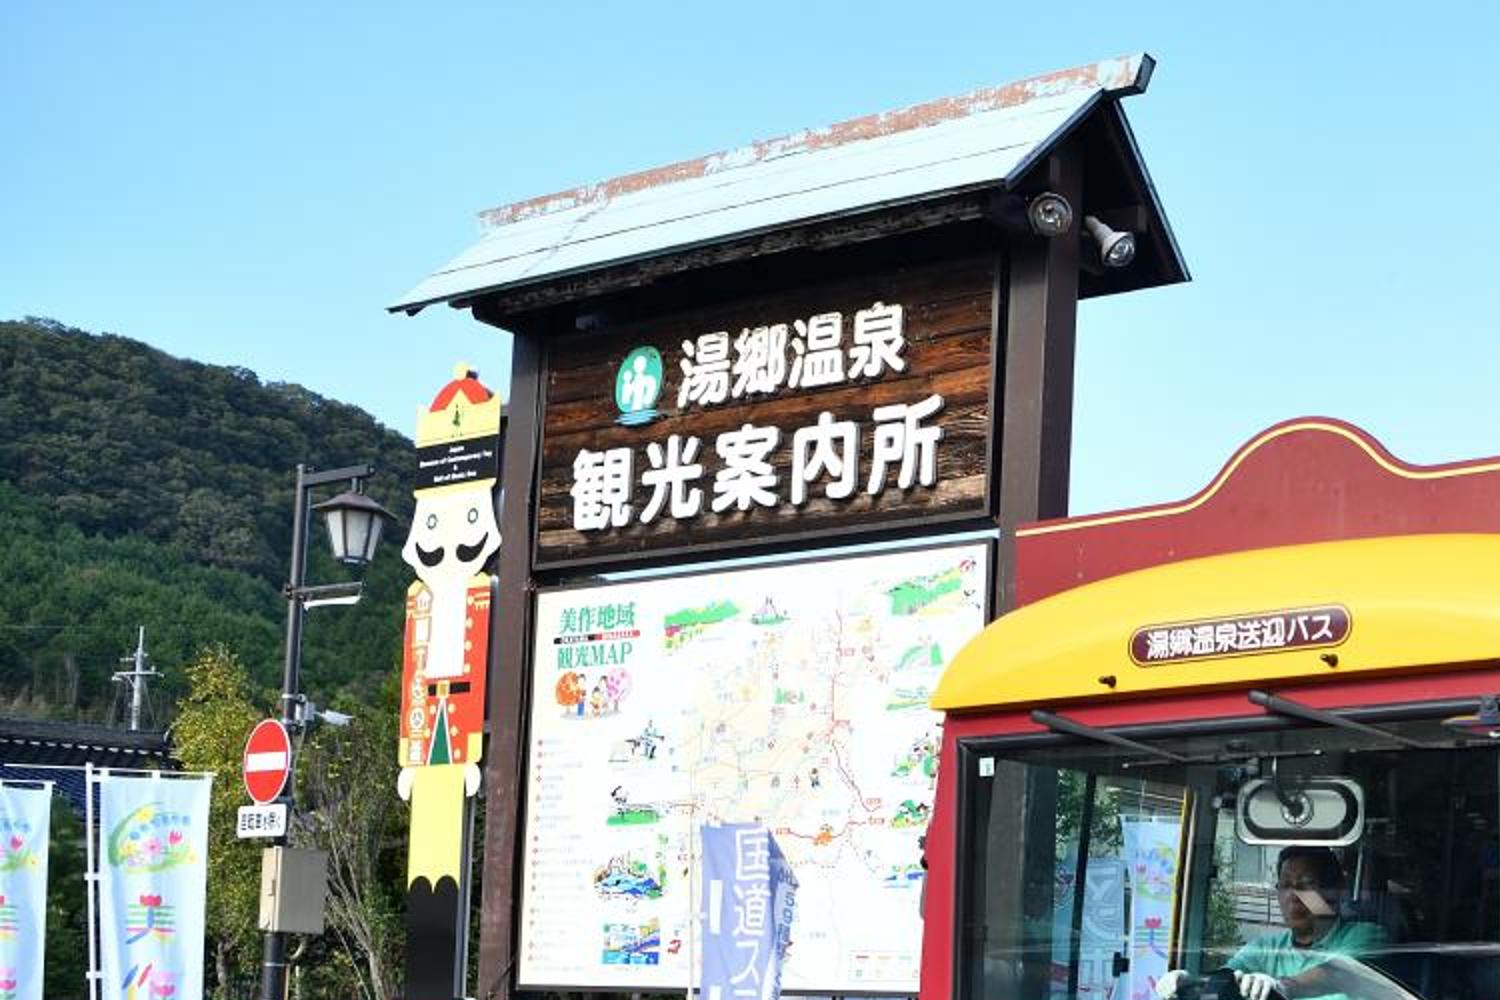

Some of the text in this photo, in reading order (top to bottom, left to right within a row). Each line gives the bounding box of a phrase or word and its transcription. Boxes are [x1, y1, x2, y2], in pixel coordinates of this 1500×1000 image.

[677, 302, 907, 409] 湯郷温泉
[570, 394, 945, 532] 観光案内所
[559, 601, 635, 633] 美作地域
[1146, 614, 1334, 660] 湯郷温泉送迎バス
[557, 641, 633, 669] 観光MAP
